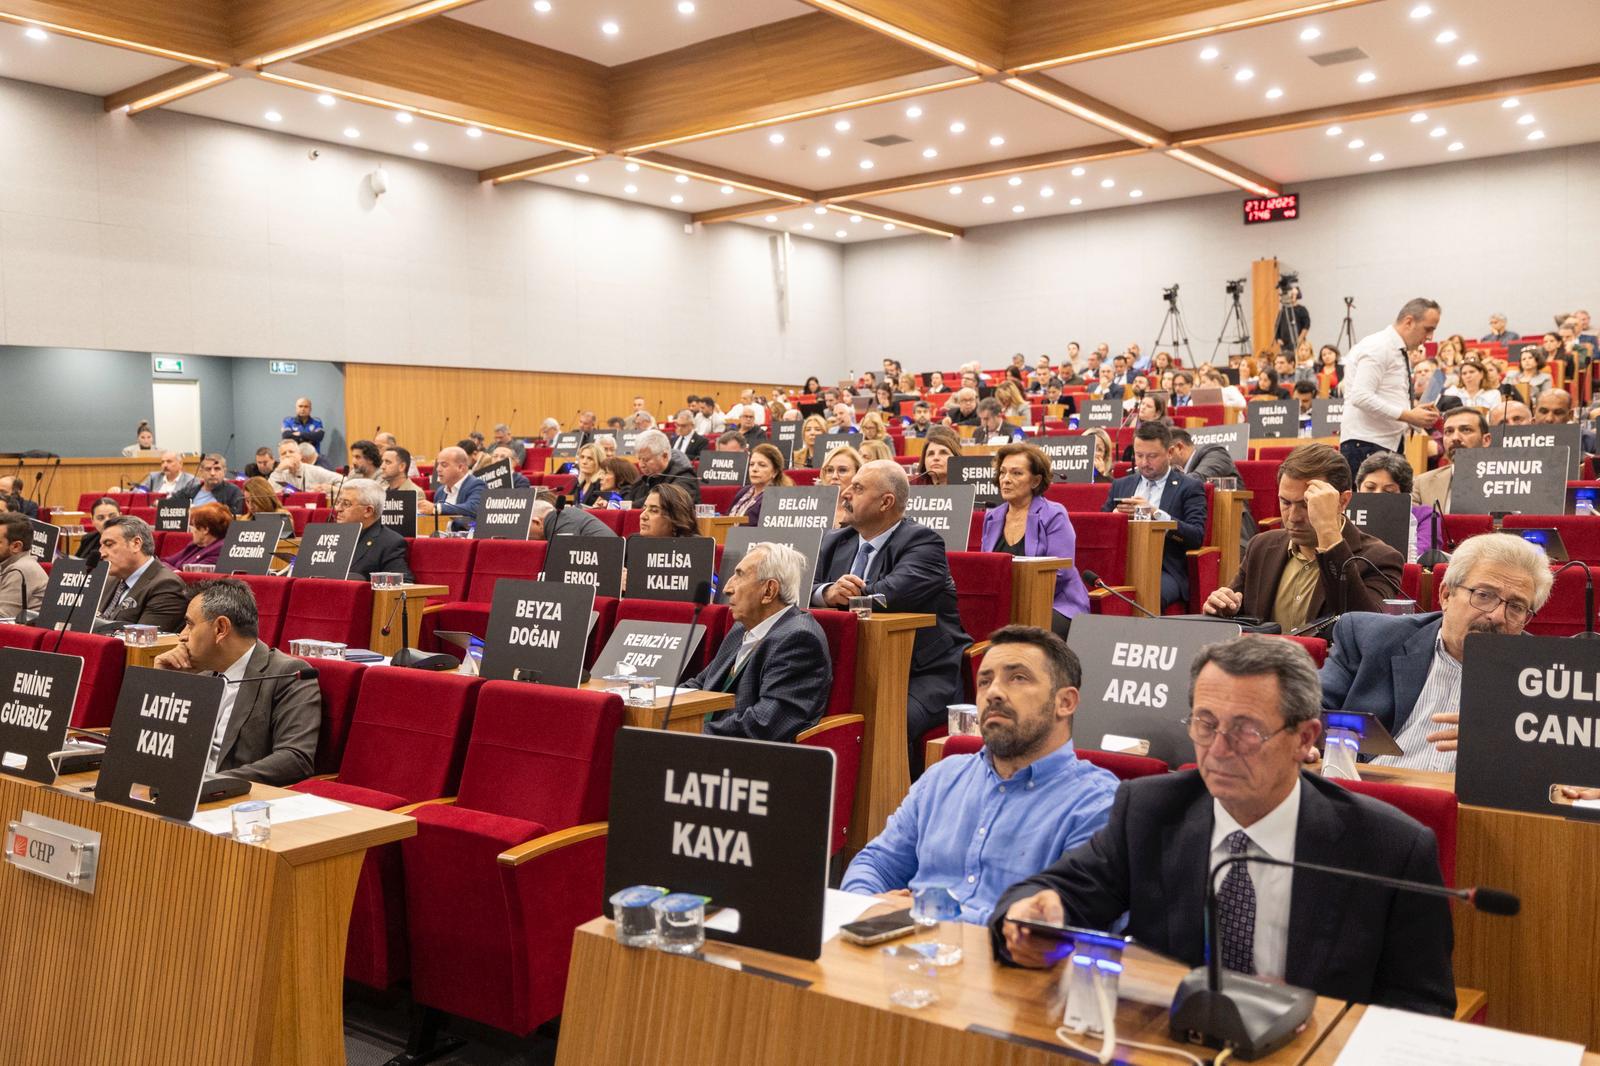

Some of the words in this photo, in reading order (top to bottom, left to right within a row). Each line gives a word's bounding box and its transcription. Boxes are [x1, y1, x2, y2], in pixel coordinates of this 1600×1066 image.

[1502, 433, 1555, 448] HATİCE
[1040, 444, 1088, 457] ÜNEVVER
[711, 458, 734, 469] PINAR
[1476, 460, 1543, 478] ŞENNUR
[703, 469, 739, 481] GÜLTEKİN
[1482, 478, 1532, 498] ÇETİN
[485, 496, 527, 510] ÜMMÜHAN
[778, 496, 819, 511] BELGİN
[380, 514, 404, 526] BULUT
[486, 513, 520, 524] KORKUT
[763, 515, 829, 528] SARILMISER
[238, 531, 266, 543] CEREN
[316, 534, 340, 549] AYŞE
[228, 544, 265, 558] ÖZDEMİR
[310, 548, 337, 565] ÇELİK
[568, 550, 599, 566] TUBA
[646, 550, 692, 569] MELİSA
[563, 570, 601, 587] ERKOL
[646, 574, 689, 591] KALEM
[515, 599, 563, 622] BEYZA
[508, 624, 561, 649] DOĞAN
[623, 633, 682, 650] REMZİYE
[623, 652, 662, 668] FIRAT
[1111, 642, 1178, 671] EBRU
[12, 669, 54, 698] EMİNE
[1102, 678, 1169, 709] ARAS
[0, 700, 52, 731] GÜRBÜZ
[140, 692, 192, 724] LATİFE
[136, 729, 175, 759] KAYA
[664, 768, 769, 816] LATİFE
[29, 838, 56, 864] CHP
[672, 821, 752, 867] KAYA
